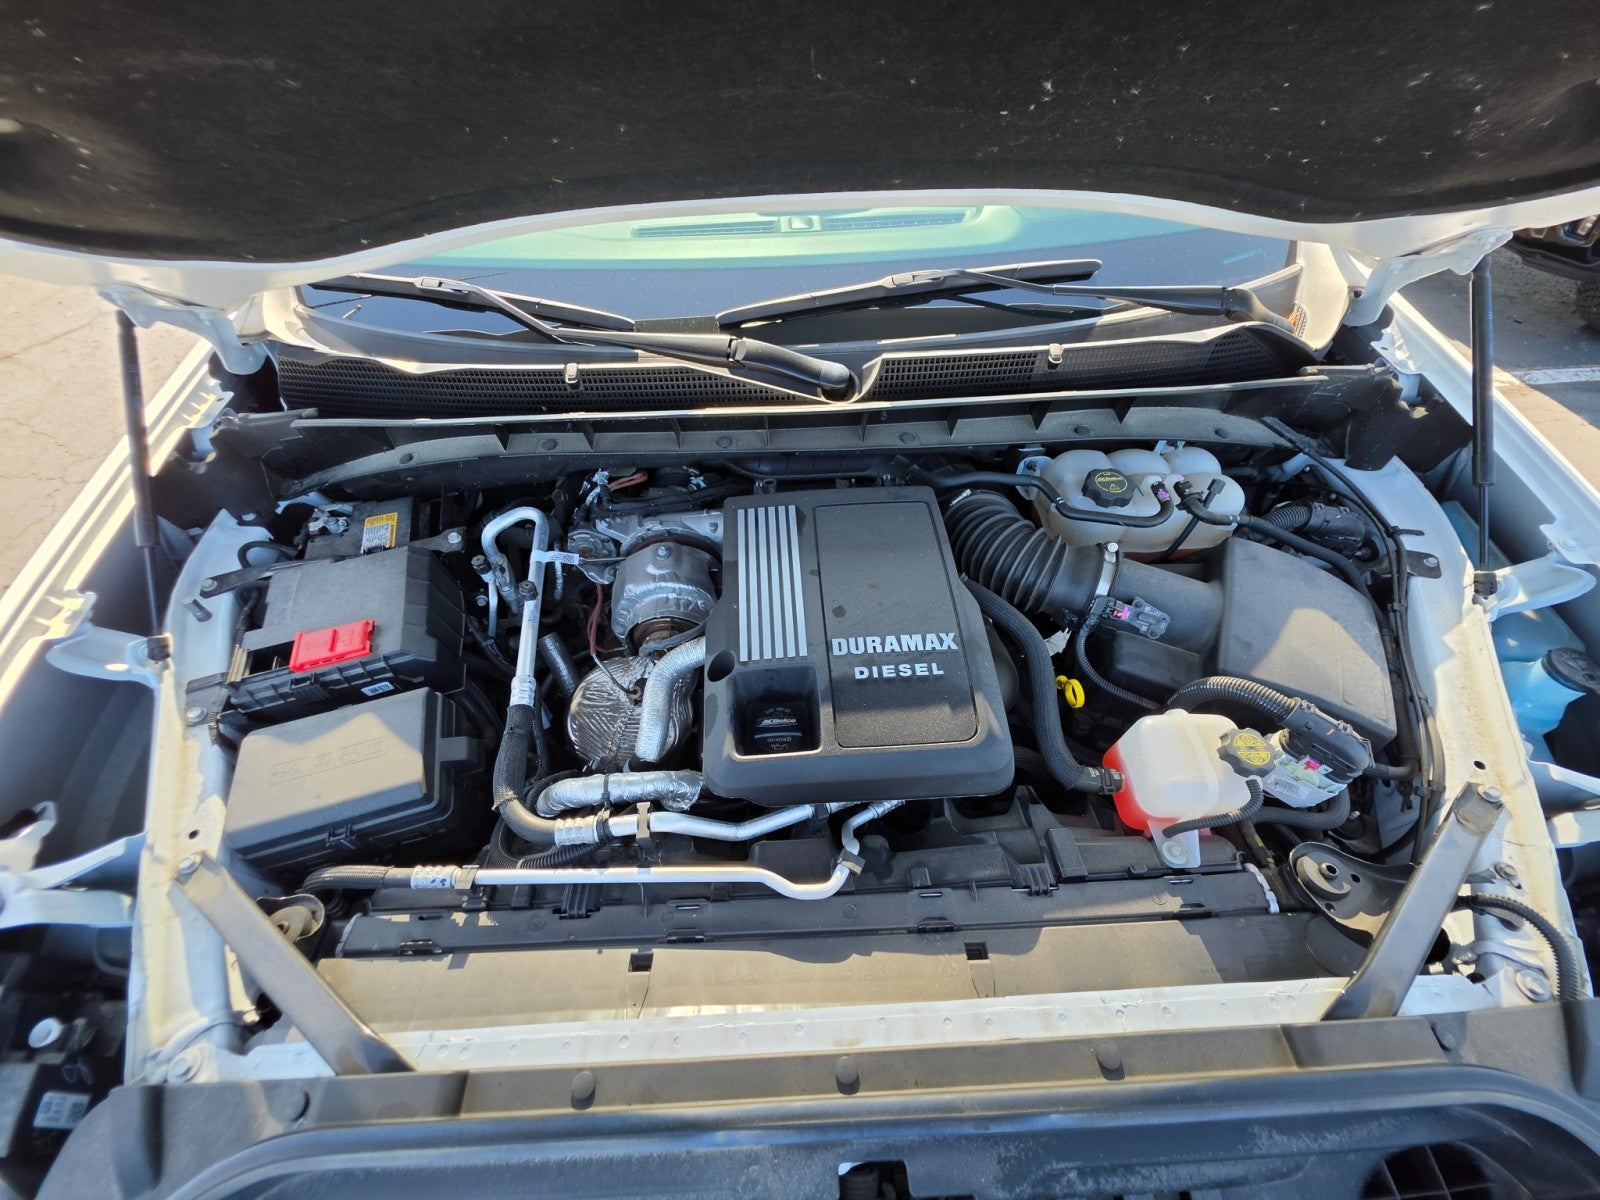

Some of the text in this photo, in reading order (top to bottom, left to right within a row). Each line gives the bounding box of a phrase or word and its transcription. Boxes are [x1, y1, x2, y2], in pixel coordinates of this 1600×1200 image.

[832, 632, 958, 655] DURAMAX
[854, 662, 944, 679] DIESEL
[760, 718, 797, 727] ACDelco
